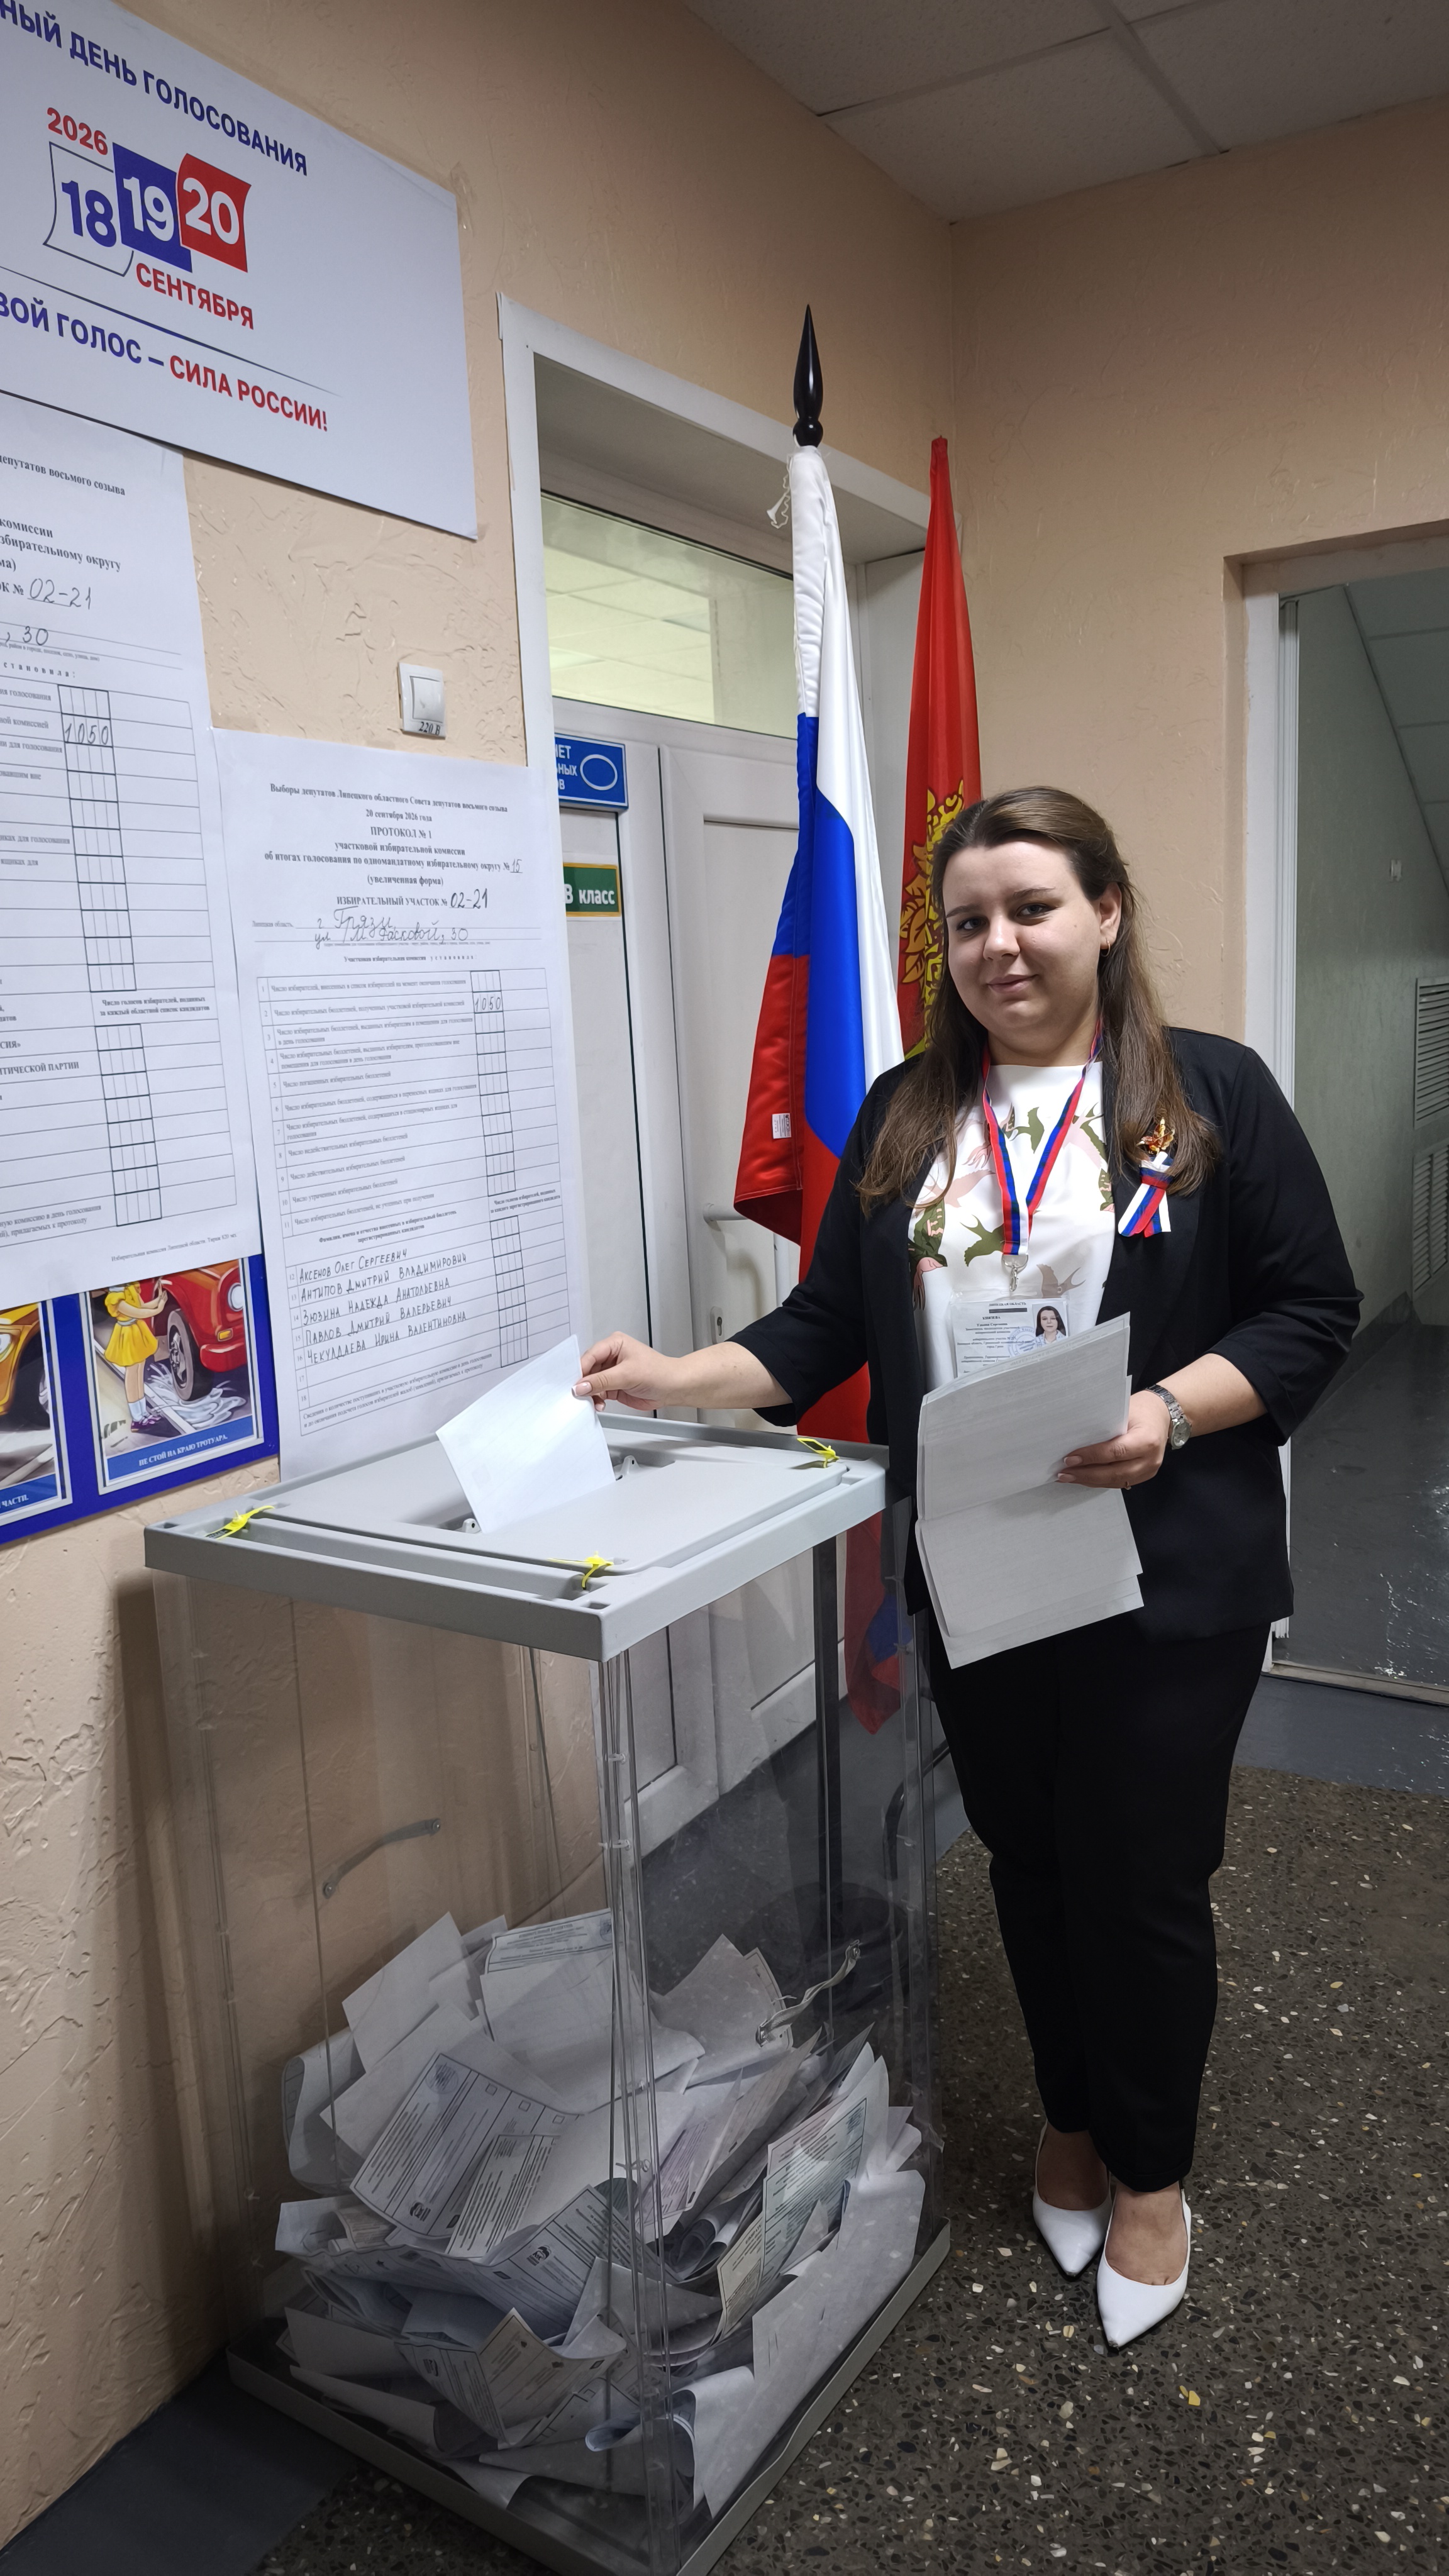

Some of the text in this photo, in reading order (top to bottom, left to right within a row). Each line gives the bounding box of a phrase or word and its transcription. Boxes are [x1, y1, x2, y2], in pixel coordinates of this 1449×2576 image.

[70, 31, 137, 86] ДЕНЬ
[143, 70, 307, 176] ГОЛОСОВАНИЯ
[47, 107, 108, 155] 2026
[61, 176, 240, 247] 18 19 20
[136, 263, 254, 330] СЕНТЯБРЯ
[57, 312, 142, 364] ГОЛОС
[170, 355, 233, 397] СИЛА
[237, 379, 328, 431] РОССИИ!
[50, 469, 91, 486] восьмого
[94, 481, 125, 496] созыва
[0, 518, 53, 538] комиссии
[86, 555, 121, 572] округу
[13, 584, 24, 595] №
[30, 579, 91, 609] 02-21
[23, 626, 48, 646] 30
[9, 689, 51, 701] голосования
[13, 718, 109, 745] комиссией 1050
[419, 721, 441, 735] 220 В
[270, 784, 300, 796] Выборы
[301, 788, 335, 797] депутатов
[337, 790, 372, 800] Липецкого
[374, 794, 409, 804] областного
[410, 796, 430, 806] Совета
[433, 800, 461, 809] депутатов
[366, 809, 373, 817] 20
[375, 811, 404, 821] сентября
[405, 812, 418, 820] 2026
[370, 826, 431, 838] ПРОТОКОЛ № 1
[335, 842, 377, 852] участковой
[380, 843, 433, 854] избирательной
[265, 851, 273, 860] об
[275, 853, 301, 862] итогах
[303, 855, 351, 863] голосования
[364, 858, 425, 869] одномандатному
[427, 859, 479, 871] избирательному
[503, 862, 509, 870] №
[367, 874, 443, 887] (увеличенная форма)
[336, 896, 404, 906] ИЗБИРАТЕЛЬНЫЙ
[406, 898, 440, 906] УЧАСТОК
[450, 888, 487, 909] 02-21
[579, 889, 615, 904] класс
[452, 928, 468, 941] 30
[475, 996, 501, 1011] 1050
[48, 1062, 79, 1072] ПАРТИИ
